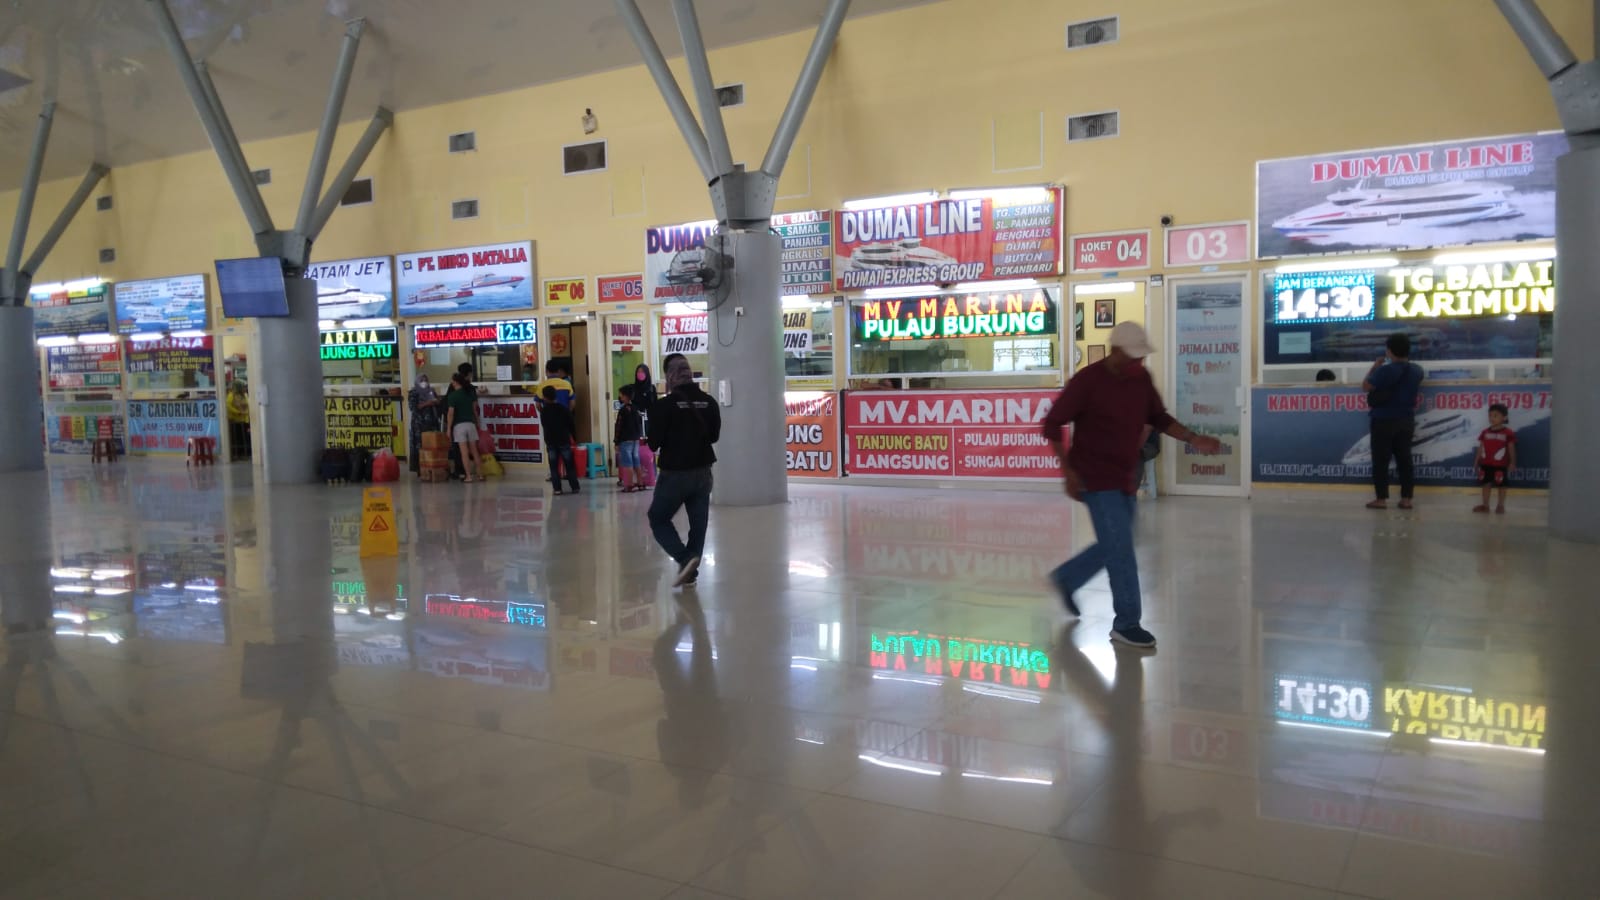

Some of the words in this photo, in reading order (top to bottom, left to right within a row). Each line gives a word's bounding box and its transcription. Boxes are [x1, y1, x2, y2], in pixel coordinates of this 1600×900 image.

[1312, 151, 1433, 183] DUMAI
[1445, 141, 1534, 169] LINE
[1014, 203, 1050, 216] SAMAK
[786, 223, 820, 236] SAMAK
[842, 206, 918, 244] DUMAI
[923, 199, 983, 236] LINE
[1010, 216, 1051, 229] PANJANG
[784, 236, 823, 249] PANJANG
[995, 228, 1052, 241] BENGKALIS
[1005, 241, 1042, 252] DUMAI
[1081, 240, 1113, 252] LOKET
[1116, 238, 1142, 262] 04
[1186, 229, 1228, 261] 03
[417, 257, 435, 273] PT.
[437, 253, 470, 271] MIKO
[472, 247, 527, 267] NATALIA
[781, 248, 823, 260] NGKALIS
[1004, 252, 1043, 264] BUTON
[1081, 253, 1098, 263] NO.
[354, 261, 384, 277] JET
[781, 260, 824, 273] UMAI
[993, 263, 1054, 277] PEKANBARU
[781, 272, 824, 284] UTON
[844, 269, 881, 289] DUMAI
[881, 265, 938, 285] EXPRESS
[940, 262, 985, 282] GROUP
[1277, 275, 1301, 290] JAM
[1302, 273, 1373, 288] BERANGKAT
[1387, 261, 1553, 294] TG.BALAI
[569, 282, 585, 300] 06
[624, 280, 643, 297] 05
[782, 284, 825, 296] KANBARU
[919, 293, 1047, 317] MARINA
[1277, 284, 1374, 320] 14:30
[1387, 286, 1555, 318] KARIMUN
[679, 315, 708, 333] TENGG
[783, 311, 807, 328] AJAR
[864, 317, 936, 341] PULAU
[942, 311, 1045, 337] BURUNG
[324, 329, 379, 345] ARINA
[499, 322, 534, 341] 12:15
[321, 345, 356, 360] JUNG
[358, 344, 392, 358] BATU
[665, 336, 698, 353] MORO
[1178, 342, 1213, 355] DUMAI
[1214, 342, 1239, 354] LINE
[342, 397, 392, 411] GROUP
[825, 398, 833, 416] 2
[1268, 394, 1332, 412] KANTOR
[1335, 394, 1371, 412] PUS
[1435, 391, 1483, 410] 0853
[1487, 390, 1535, 409] 6579
[202, 402, 217, 418] 02
[483, 403, 539, 419] NATALIA
[859, 398, 1055, 425] MV.MARINA
[327, 429, 352, 440] RUNG
[856, 434, 912, 451] TANJUNG
[914, 434, 949, 451] BATU
[964, 433, 1000, 446] PULAU
[1002, 433, 1049, 446] BURUNG
[786, 450, 833, 471] BATU
[856, 454, 950, 471] LANGSUNG
[964, 455, 1005, 469] SUNGAI
[1007, 455, 1061, 470] GUNTUNG
